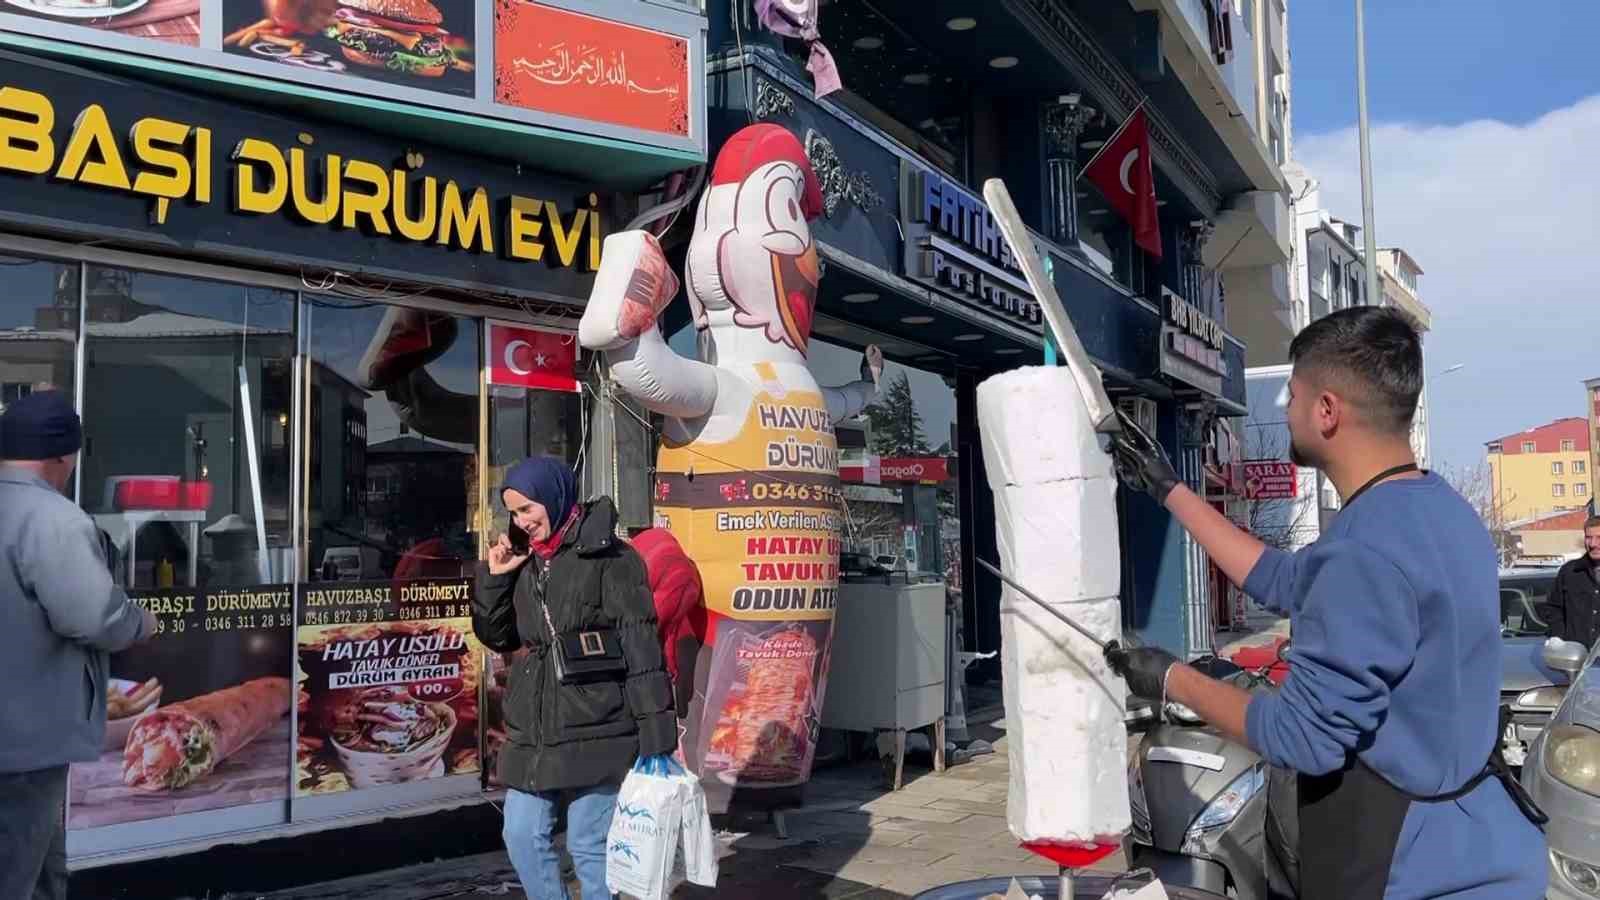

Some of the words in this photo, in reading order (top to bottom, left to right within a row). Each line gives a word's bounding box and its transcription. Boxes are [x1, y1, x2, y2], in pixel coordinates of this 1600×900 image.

[231, 132, 494, 254] DÜRÜM
[511, 192, 601, 273] EVİ
[1245, 464, 1292, 476] SARAY
[752, 482, 809, 501] 0346
[717, 510, 766, 531] Emek
[768, 510, 818, 531] Verilen
[747, 536, 823, 556] HATAY
[741, 562, 825, 581] TAVUK
[207, 588, 291, 611] DÜRÜMEVİ
[306, 588, 392, 607] HAVUZBAŞI
[400, 580, 470, 602] DÜRÜMEVİ
[733, 587, 807, 610] ODUN
[172, 619, 185, 633] 30
[205, 616, 231, 632] 0346
[237, 615, 255, 629] 311
[261, 614, 274, 628] 28
[279, 613, 292, 627] 58
[305, 611, 329, 625] 0546
[334, 610, 351, 624] 872
[356, 609, 368, 622] 39
[372, 608, 384, 621] 30
[399, 606, 421, 620] 0346
[425, 605, 441, 618] 311
[444, 605, 456, 617] 28
[460, 604, 471, 616] 58
[322, 637, 397, 661] HATAY
[738, 649, 780, 658] Tavuk
[402, 666, 454, 680] AYRAN
